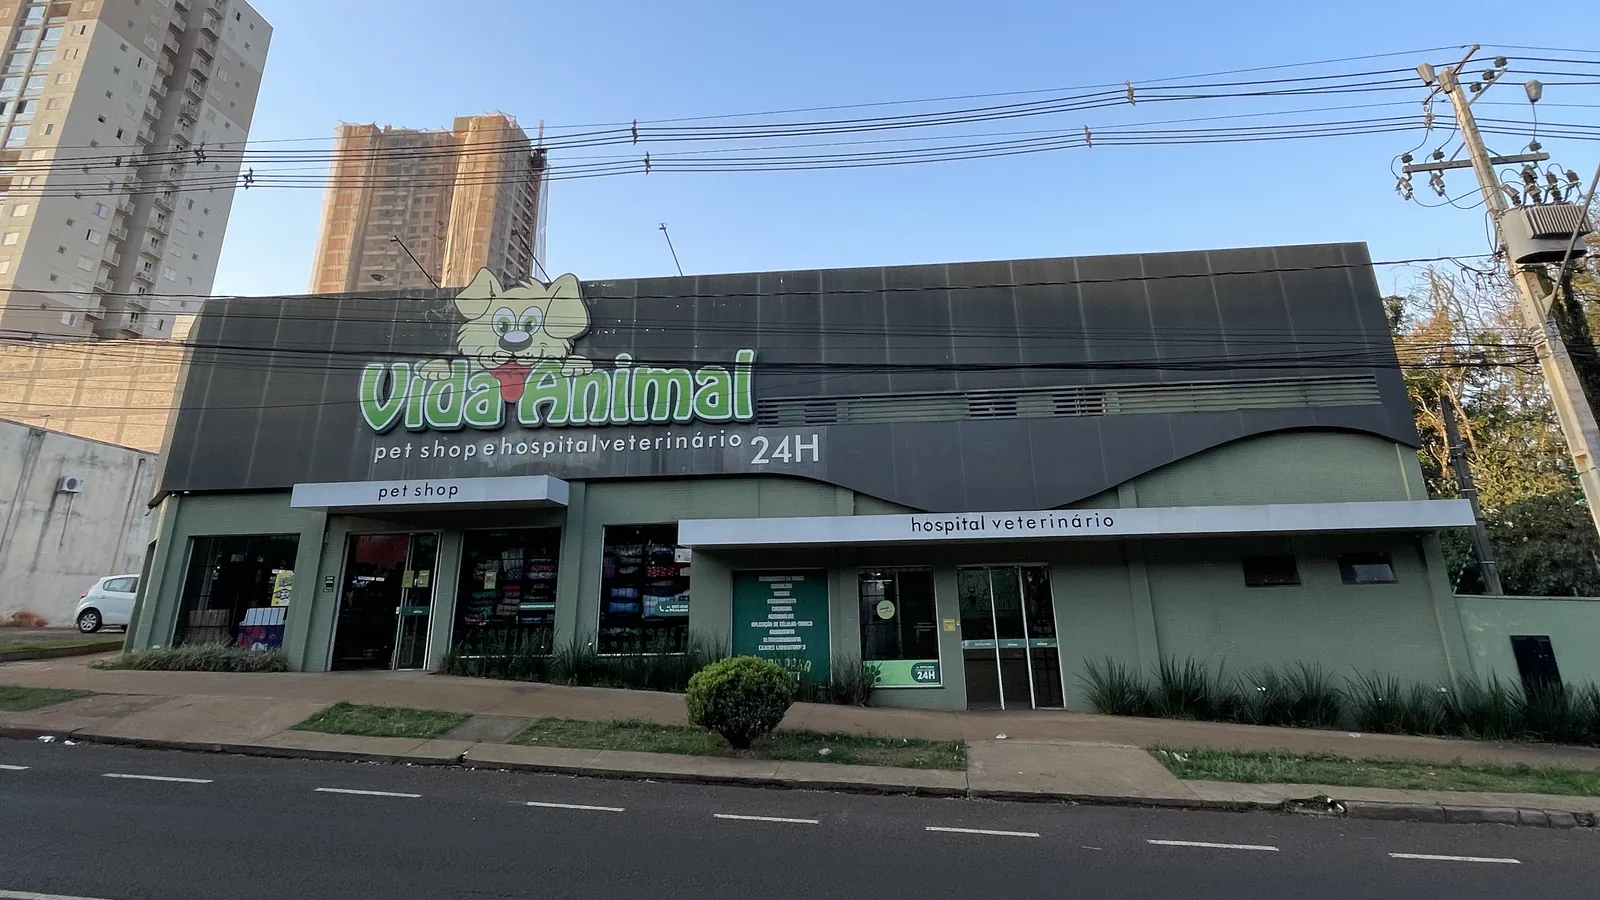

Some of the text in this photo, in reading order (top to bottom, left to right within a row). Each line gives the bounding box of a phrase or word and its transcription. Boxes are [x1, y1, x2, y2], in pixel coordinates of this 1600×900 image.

[359, 348, 755, 432] Vida Animal
[374, 429, 820, 464] pet shop e hospital veterinário 24H
[378, 482, 458, 501] pet shop
[911, 512, 1114, 535] hospital veterinário
[917, 671, 936, 680] 24H
